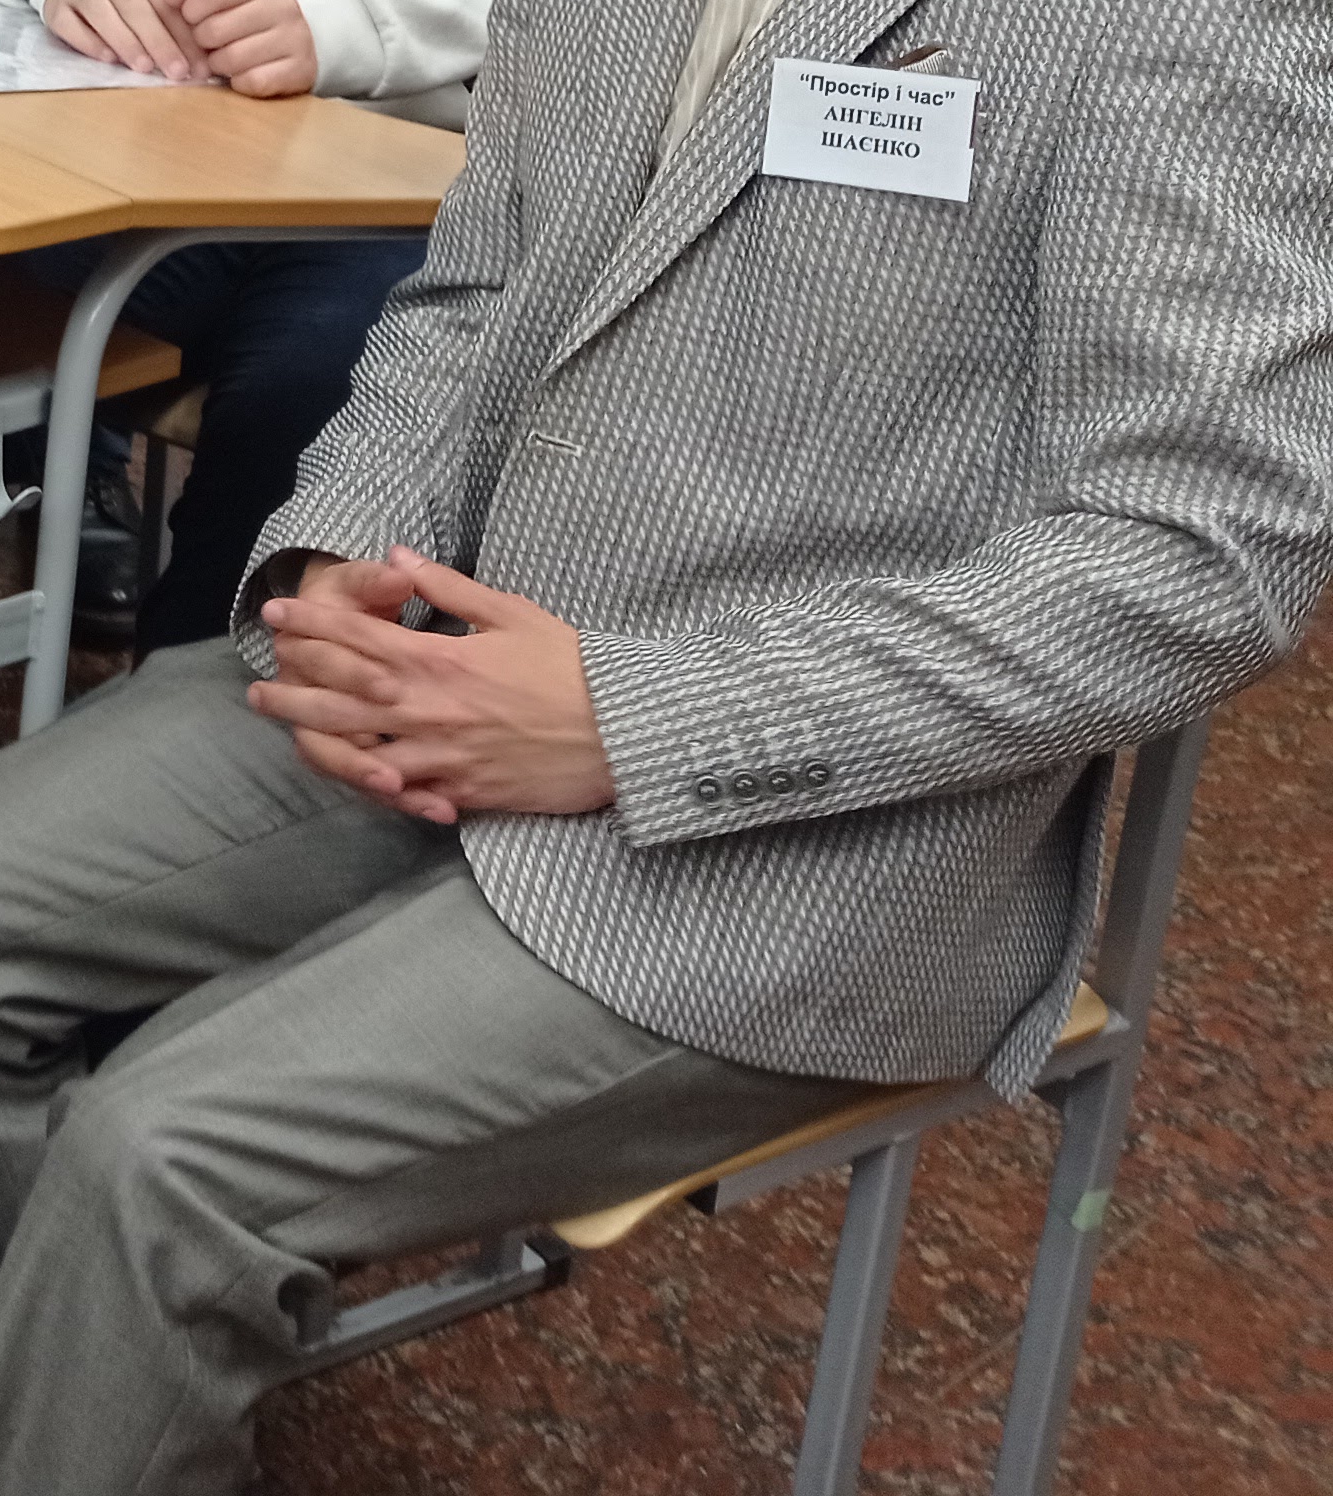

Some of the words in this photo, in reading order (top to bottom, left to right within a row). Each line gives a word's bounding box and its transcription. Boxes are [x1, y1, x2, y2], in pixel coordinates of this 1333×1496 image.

[896, 85, 901, 101] і
[824, 105, 923, 132] АНГЕЛІН
[821, 131, 921, 159] ШАЄНКО
